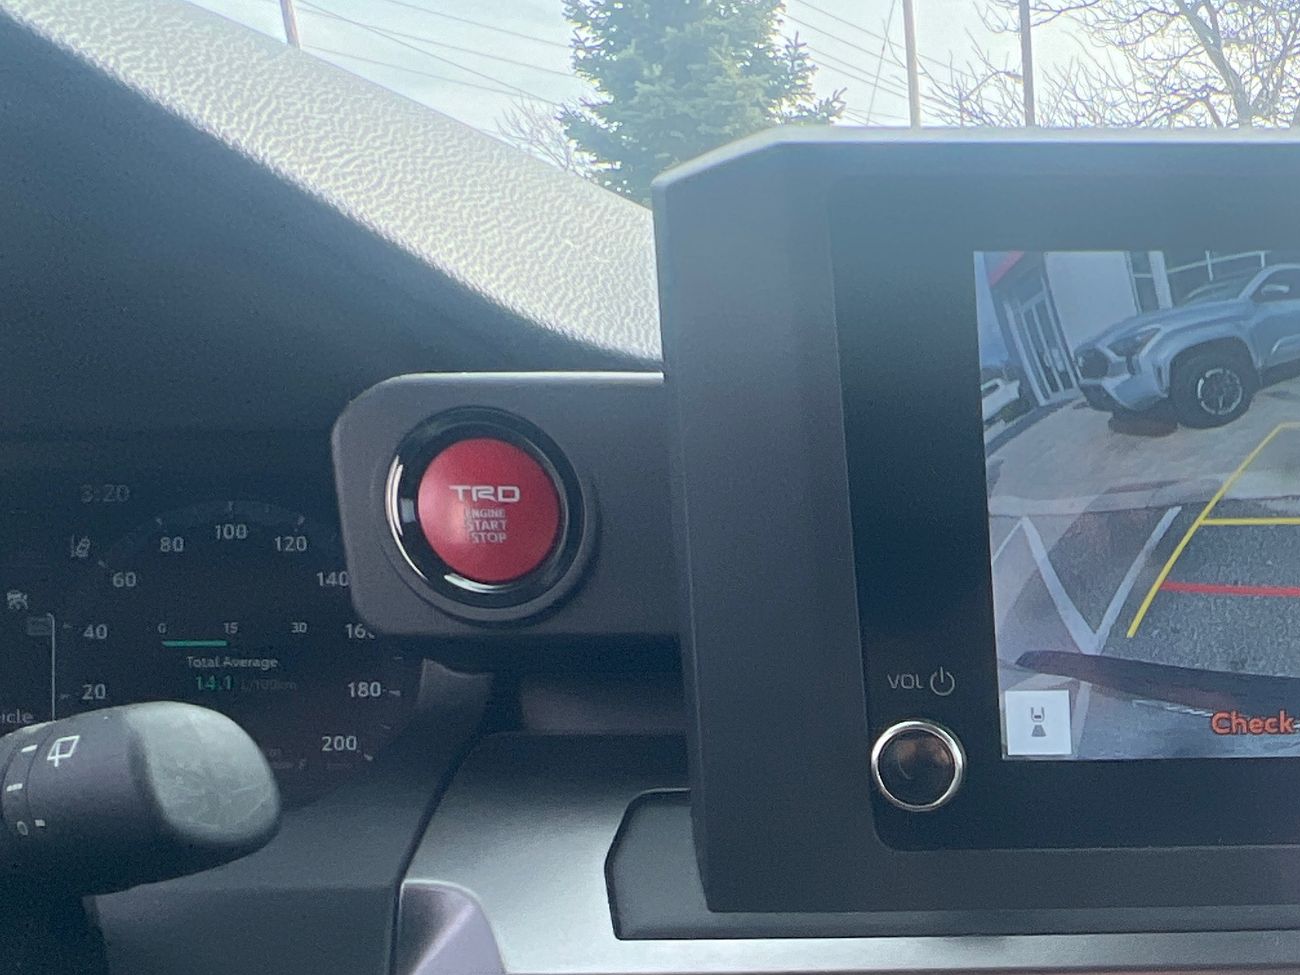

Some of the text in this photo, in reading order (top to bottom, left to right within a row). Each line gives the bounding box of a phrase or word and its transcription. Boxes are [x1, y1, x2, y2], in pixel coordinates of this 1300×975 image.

[449, 485, 520, 503] TRD
[464, 508, 506, 518] ENGINE
[215, 525, 247, 540] 100
[466, 519, 507, 530] START
[160, 536, 184, 552] 80
[274, 536, 308, 552] 120
[471, 532, 507, 544] STOP
[112, 572, 137, 588] 60
[316, 571, 348, 586] 140
[83, 624, 108, 640] 40
[223, 622, 239, 634] 15
[291, 622, 308, 634] 30
[186, 655, 279, 671] Total Average
[196, 676, 232, 691] 14.1
[888, 673, 924, 689] VOL
[82, 684, 106, 699] 20
[348, 681, 382, 698] 180
[1211, 710, 1294, 735] Check
[321, 736, 357, 752] 200
